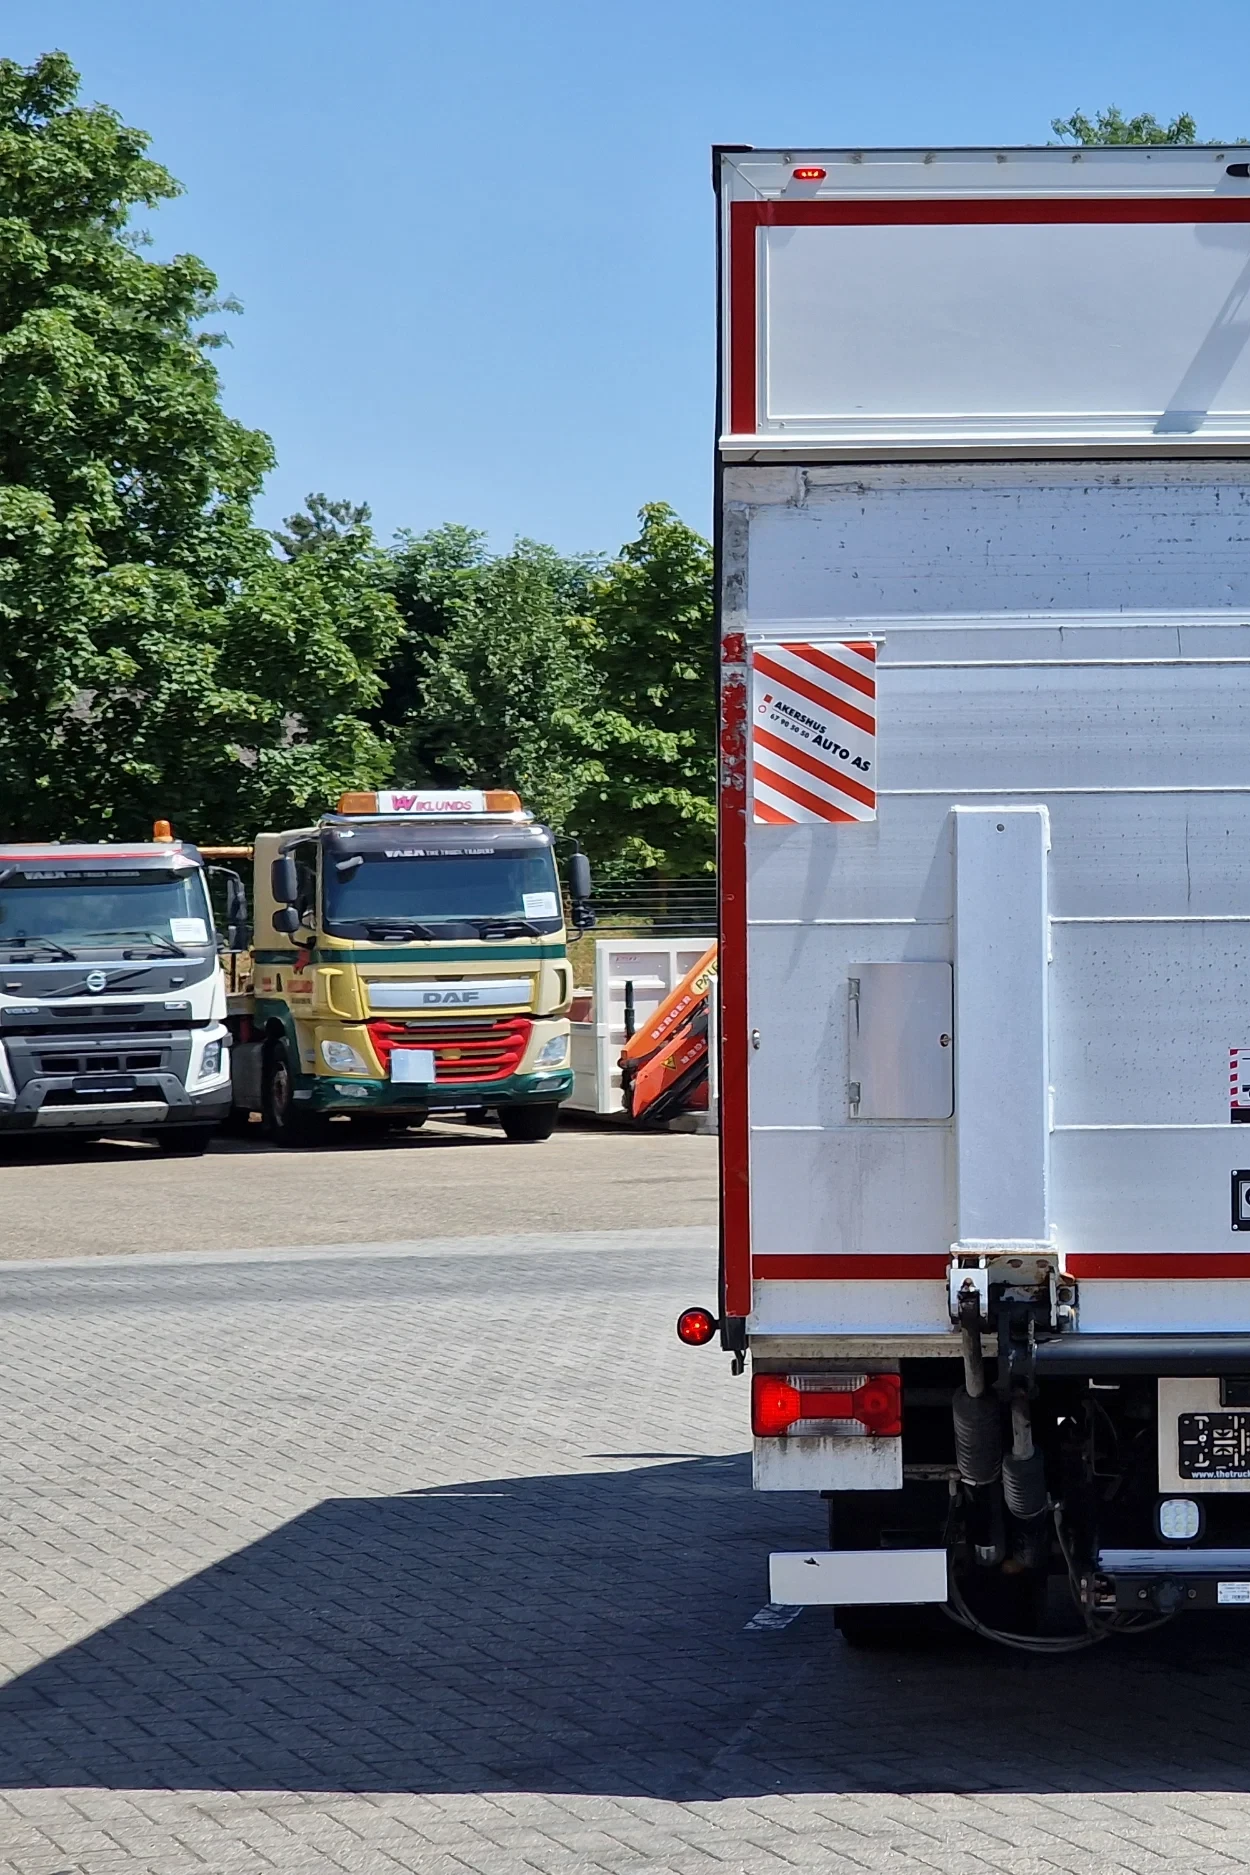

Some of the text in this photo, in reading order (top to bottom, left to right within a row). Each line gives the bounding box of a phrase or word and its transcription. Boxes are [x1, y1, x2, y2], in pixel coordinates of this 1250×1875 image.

[774, 701, 827, 735] AKERSHUS
[811, 735, 871, 772] AUTO AS
[422, 992, 479, 1004] DAF
[651, 995, 692, 1040] BERGER
